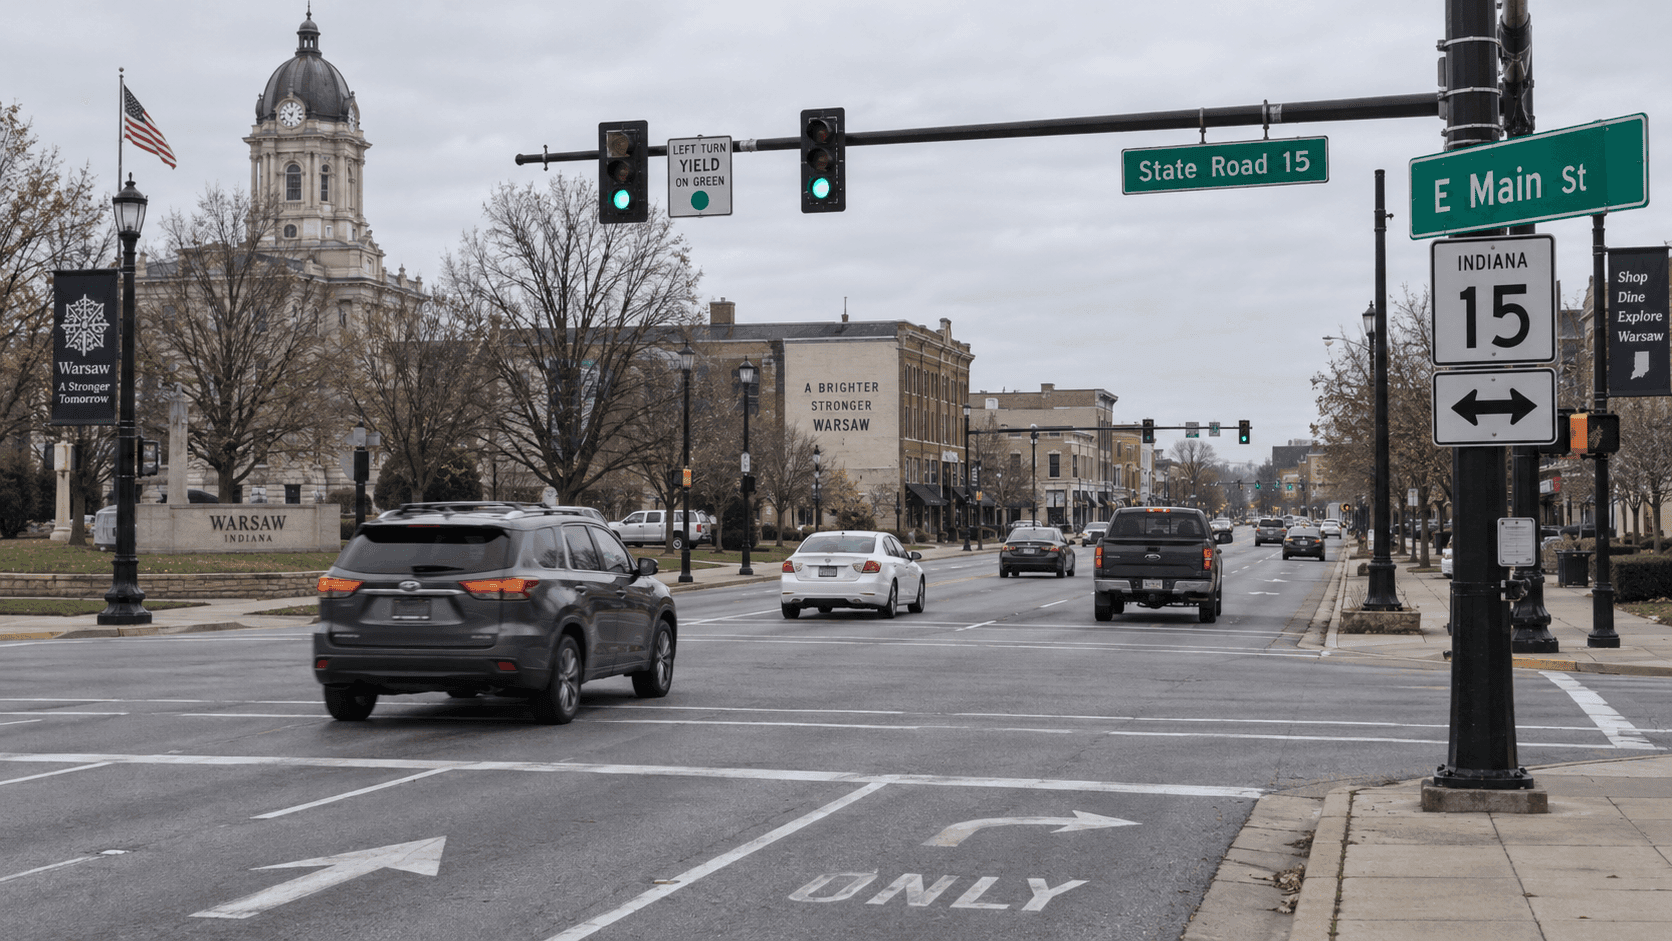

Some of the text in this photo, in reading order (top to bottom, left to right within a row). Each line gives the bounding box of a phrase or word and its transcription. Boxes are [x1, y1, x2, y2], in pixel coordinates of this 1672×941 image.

[673, 143, 726, 155] LEFT TURN
[679, 158, 720, 173] YIELD
[1139, 150, 1310, 182] State Road 15
[675, 175, 725, 187] ON GREEN
[1434, 163, 1587, 213] E Main St
[1458, 252, 1528, 271] INDIANA
[1617, 270, 1648, 285] Shop
[1617, 290, 1645, 303] Dine
[1460, 284, 1530, 349] 15
[1617, 310, 1663, 325] Explore
[1617, 331, 1664, 342] Warsaw
[58, 361, 110, 375] Warsaw
[58, 381, 110, 394] A Stronger
[804, 382, 879, 393] A BRIGHTER
[59, 394, 109, 404] Tomorrow
[811, 400, 872, 411] STRONGER
[813, 418, 870, 432] WARSAW
[209, 515, 287, 531] WARSAW
[224, 534, 273, 543] INDIANA
[788, 871, 1090, 911] ONLY
